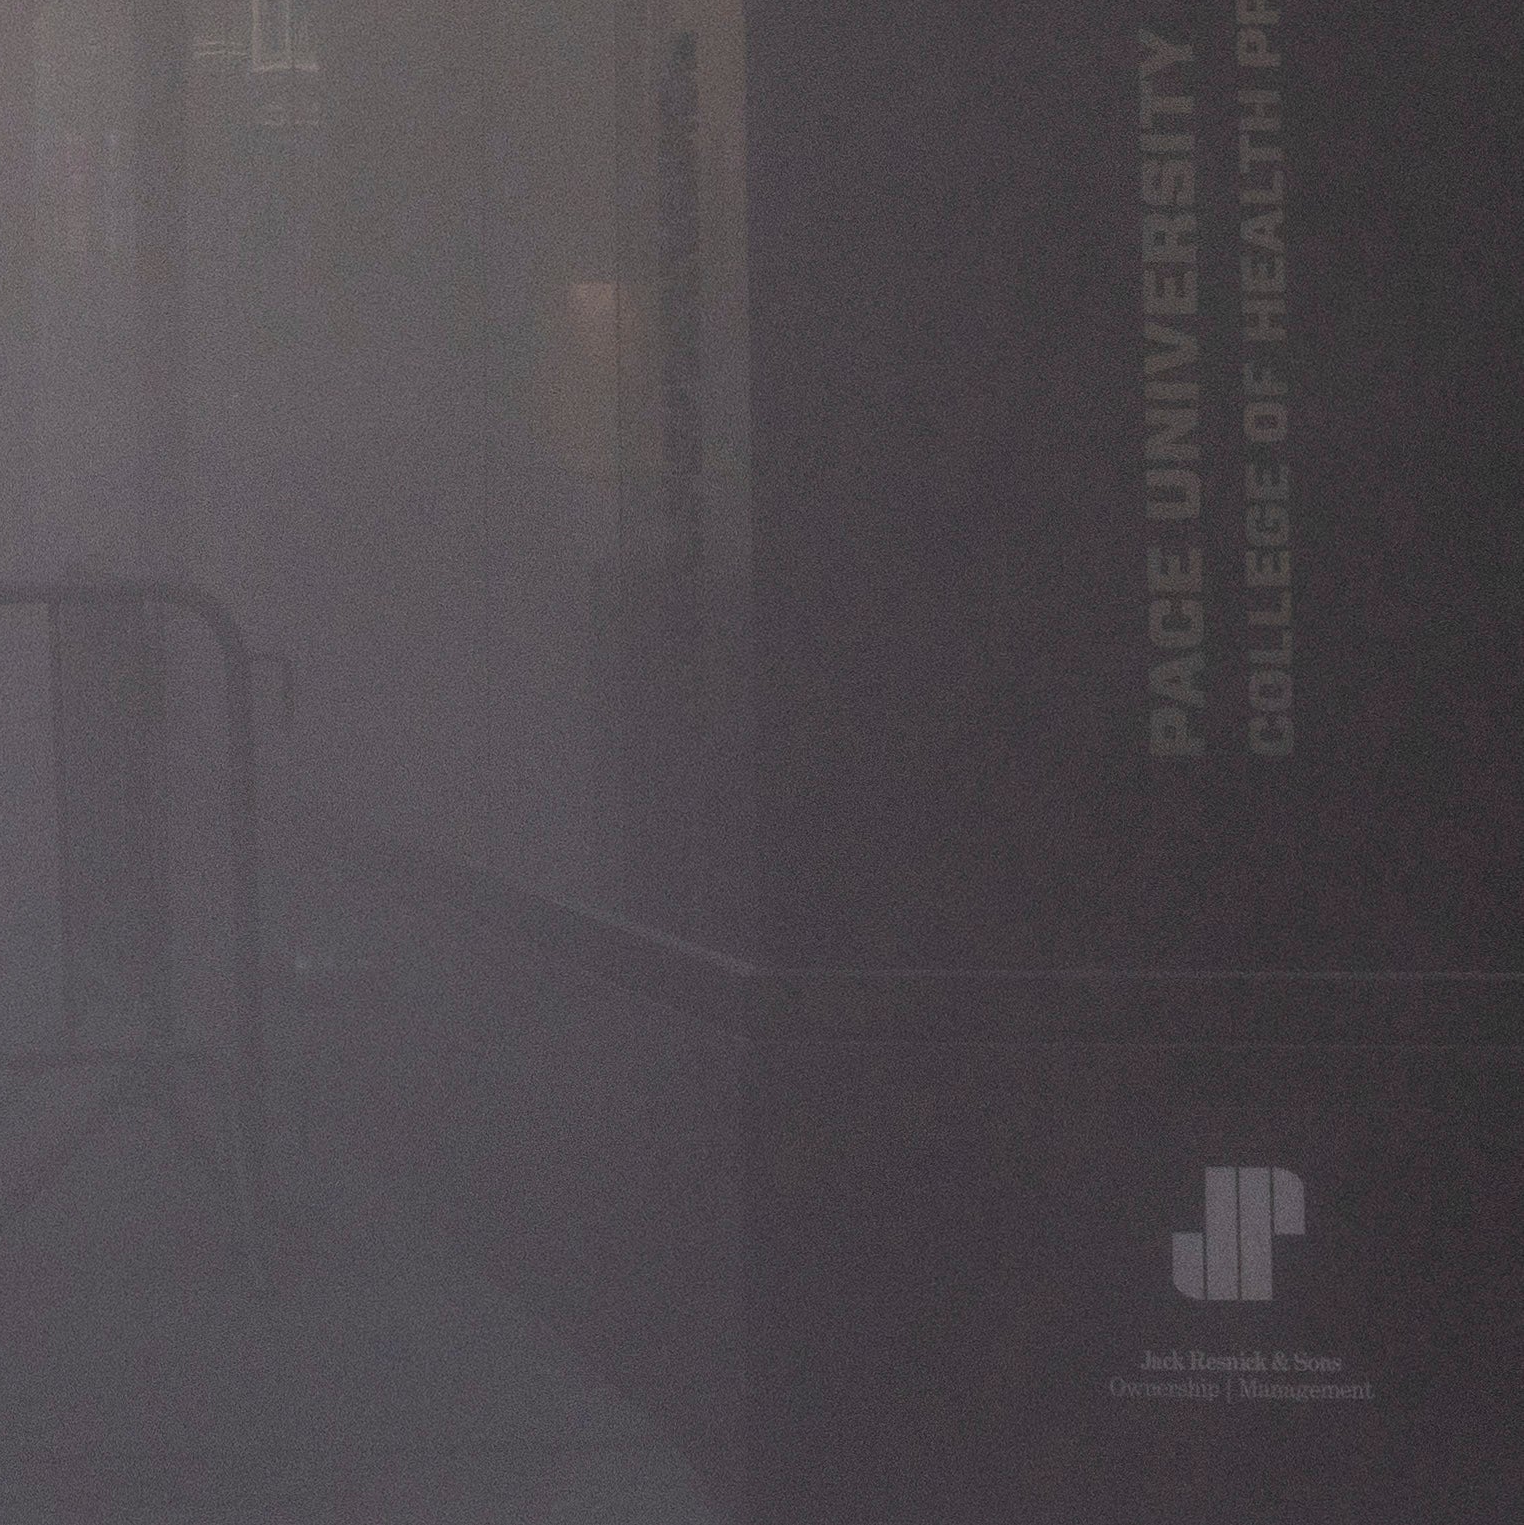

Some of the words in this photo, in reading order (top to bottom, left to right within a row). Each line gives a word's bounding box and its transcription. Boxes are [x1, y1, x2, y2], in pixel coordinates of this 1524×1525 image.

[1138, 28, 1202, 520] UNIVERSITY
[1237, 89, 1287, 342] HEALTH
[1241, 360, 1289, 443] OF
[1147, 547, 1206, 756] PACE
[1243, 463, 1295, 756] COLLEGE
[1109, 1374, 1220, 1402] Ownership
[1238, 1376, 1376, 1402] Management
[1140, 1349, 1186, 1371] Jack
[1189, 1349, 1268, 1371] Resnick
[1272, 1350, 1291, 1372] &
[1294, 1352, 1343, 1372] Sons
